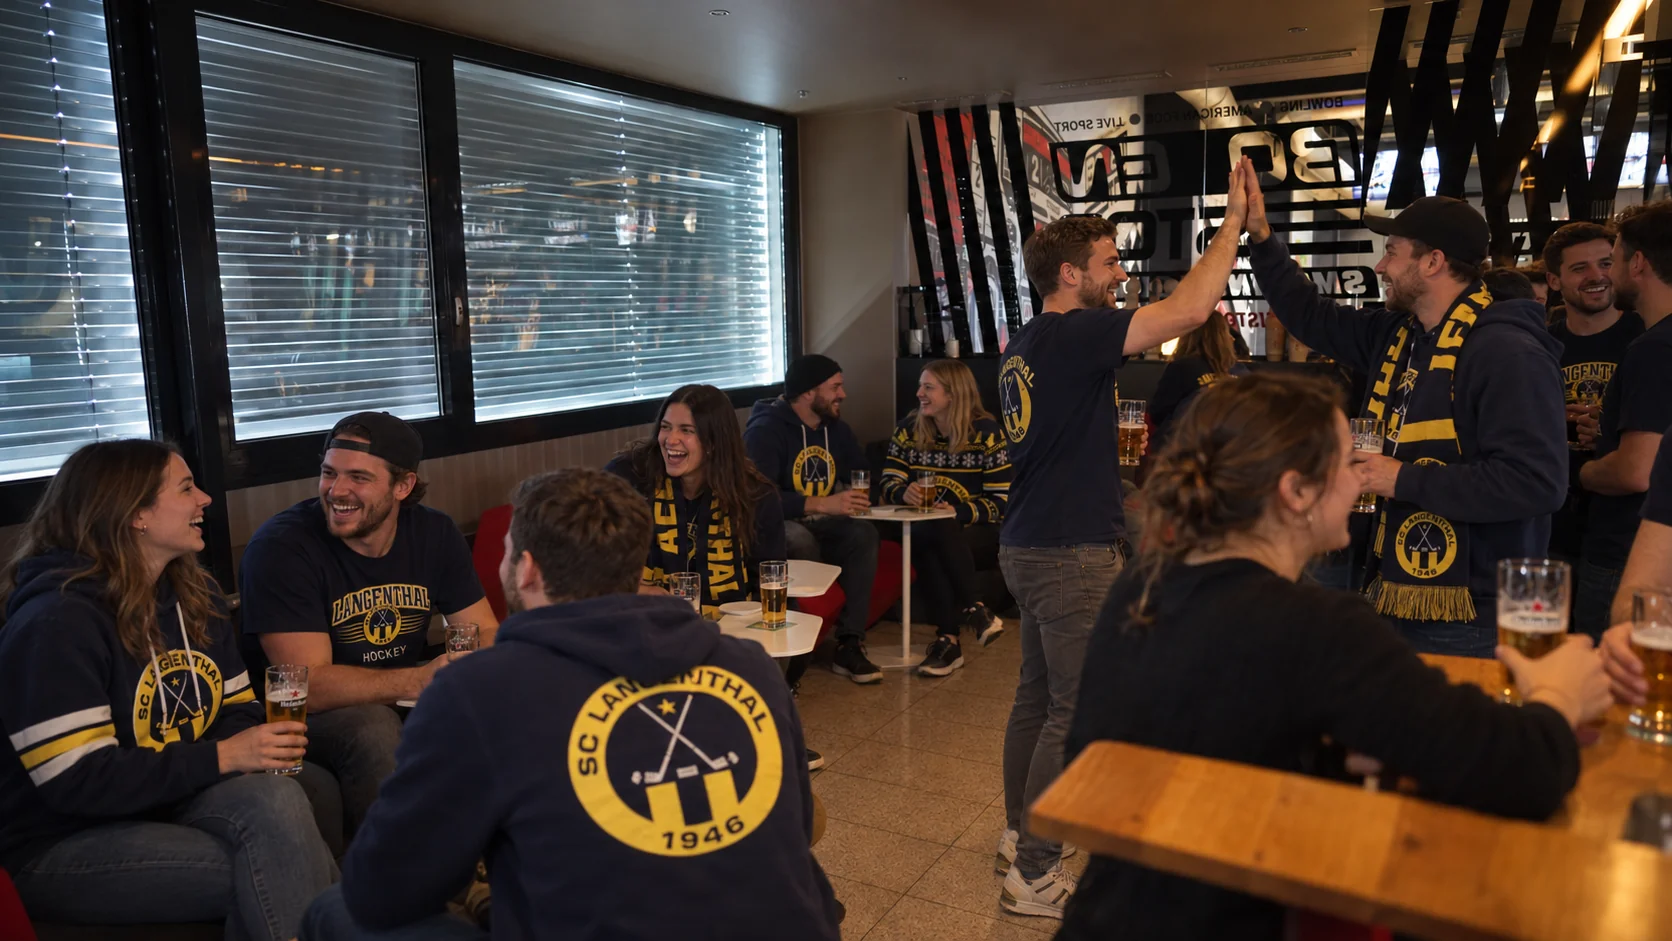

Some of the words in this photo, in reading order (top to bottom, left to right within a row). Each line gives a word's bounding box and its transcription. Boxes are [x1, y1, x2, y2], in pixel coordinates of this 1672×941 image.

[1561, 362, 1618, 384] NGENT
[332, 583, 430, 627] LANGENTHAL
[363, 645, 407, 662] HOCKEY
[139, 694, 150, 720] SC
[578, 734, 598, 776] SC
[588, 670, 768, 734] LANNTHAL
[662, 815, 745, 849] 1946
